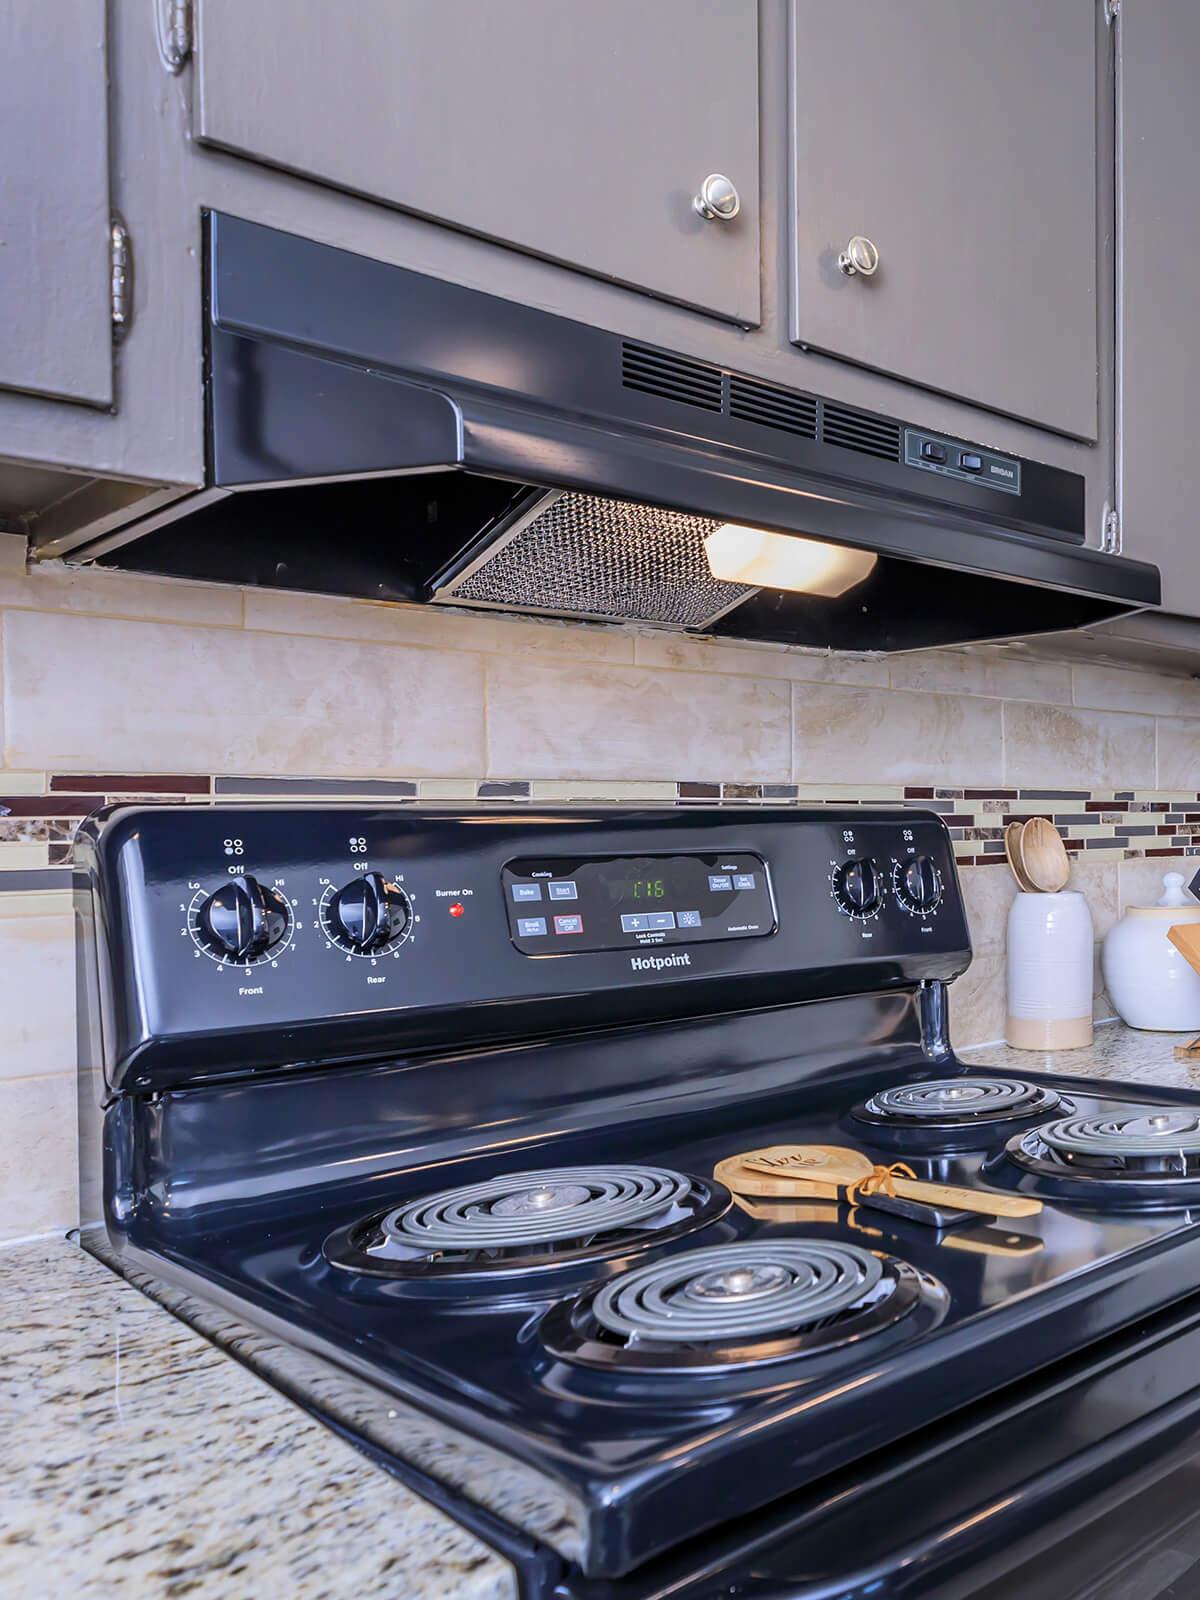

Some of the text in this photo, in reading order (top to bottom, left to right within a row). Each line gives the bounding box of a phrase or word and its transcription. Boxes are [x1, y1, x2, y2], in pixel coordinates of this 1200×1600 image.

[990, 465, 1014, 479] BROAN
[228, 865, 245, 874] Off
[319, 877, 330, 885] Lo
[462, 888, 473, 896] On
[181, 928, 187, 936] 2
[271, 960, 278, 968] 6
[630, 953, 691, 971] Hotpoint
[245, 968, 252, 976] 5
[367, 976, 386, 984] Rear
[238, 986, 264, 995] Front
